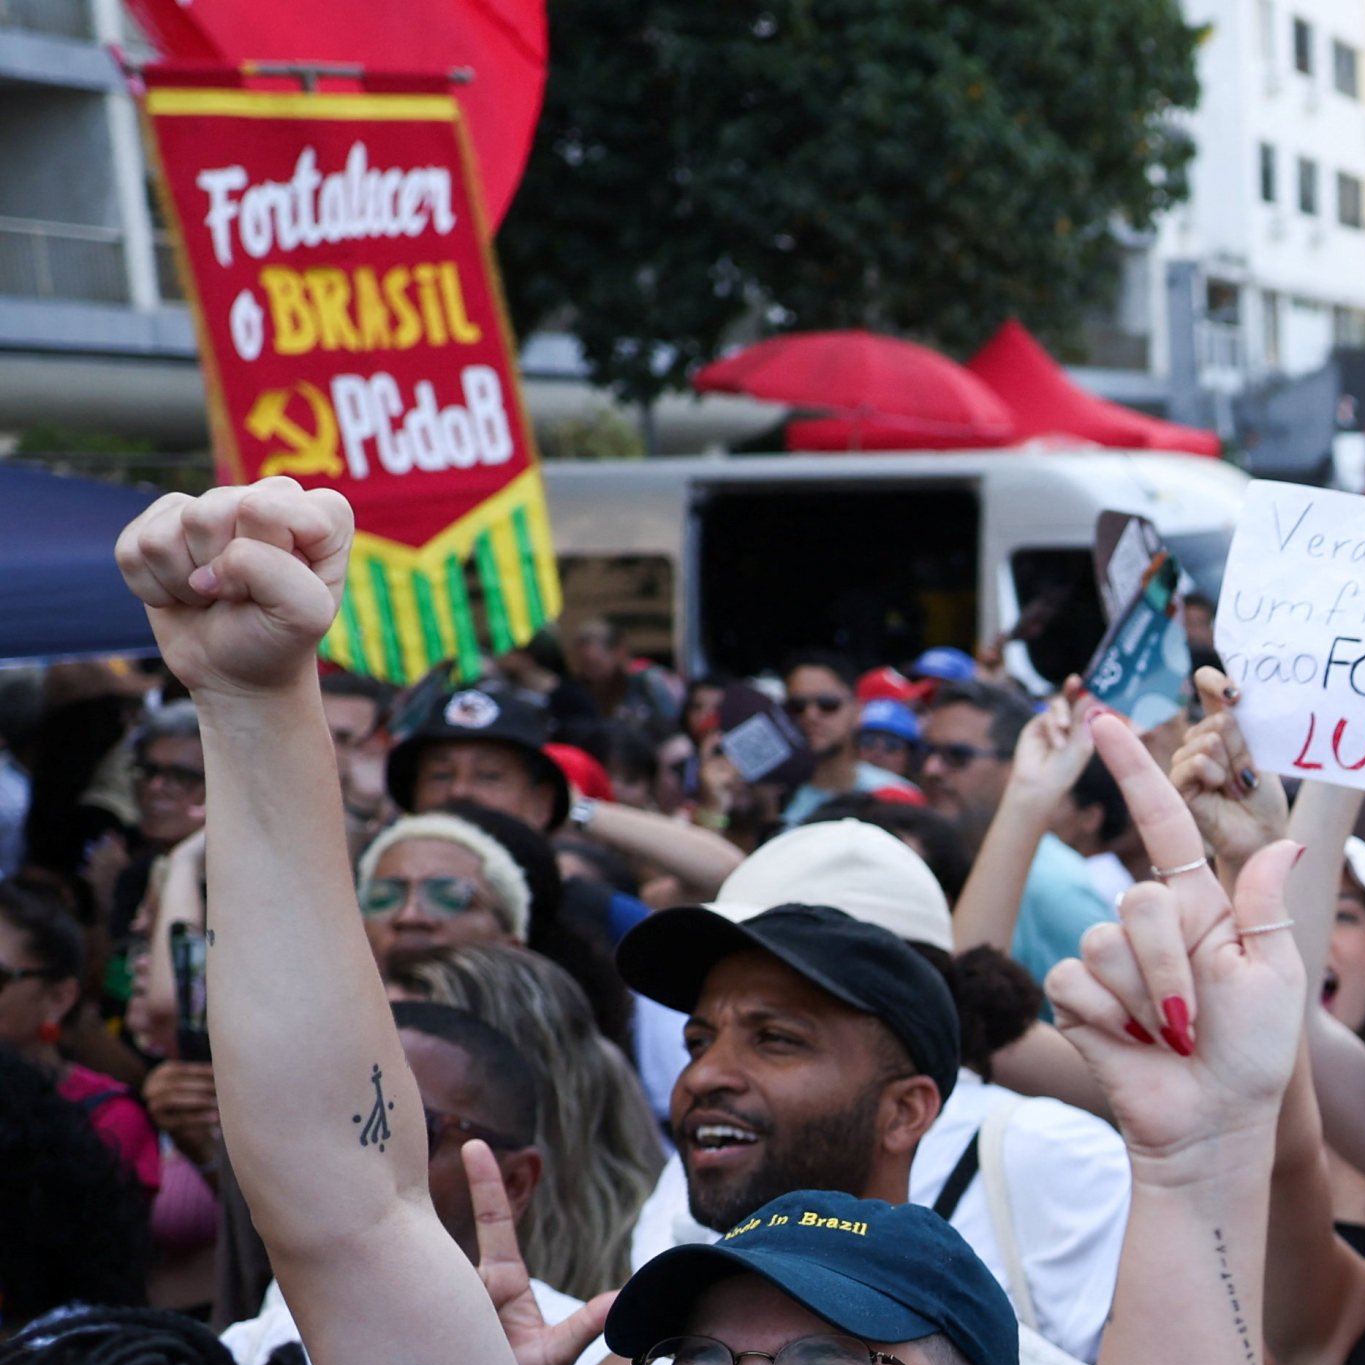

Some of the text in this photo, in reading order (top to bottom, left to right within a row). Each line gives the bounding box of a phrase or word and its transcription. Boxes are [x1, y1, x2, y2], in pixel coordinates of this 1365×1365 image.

[196, 139, 456, 267] Fortalecer
[330, 363, 513, 480] PCdoB
[797, 1211, 868, 1236] Brazil
